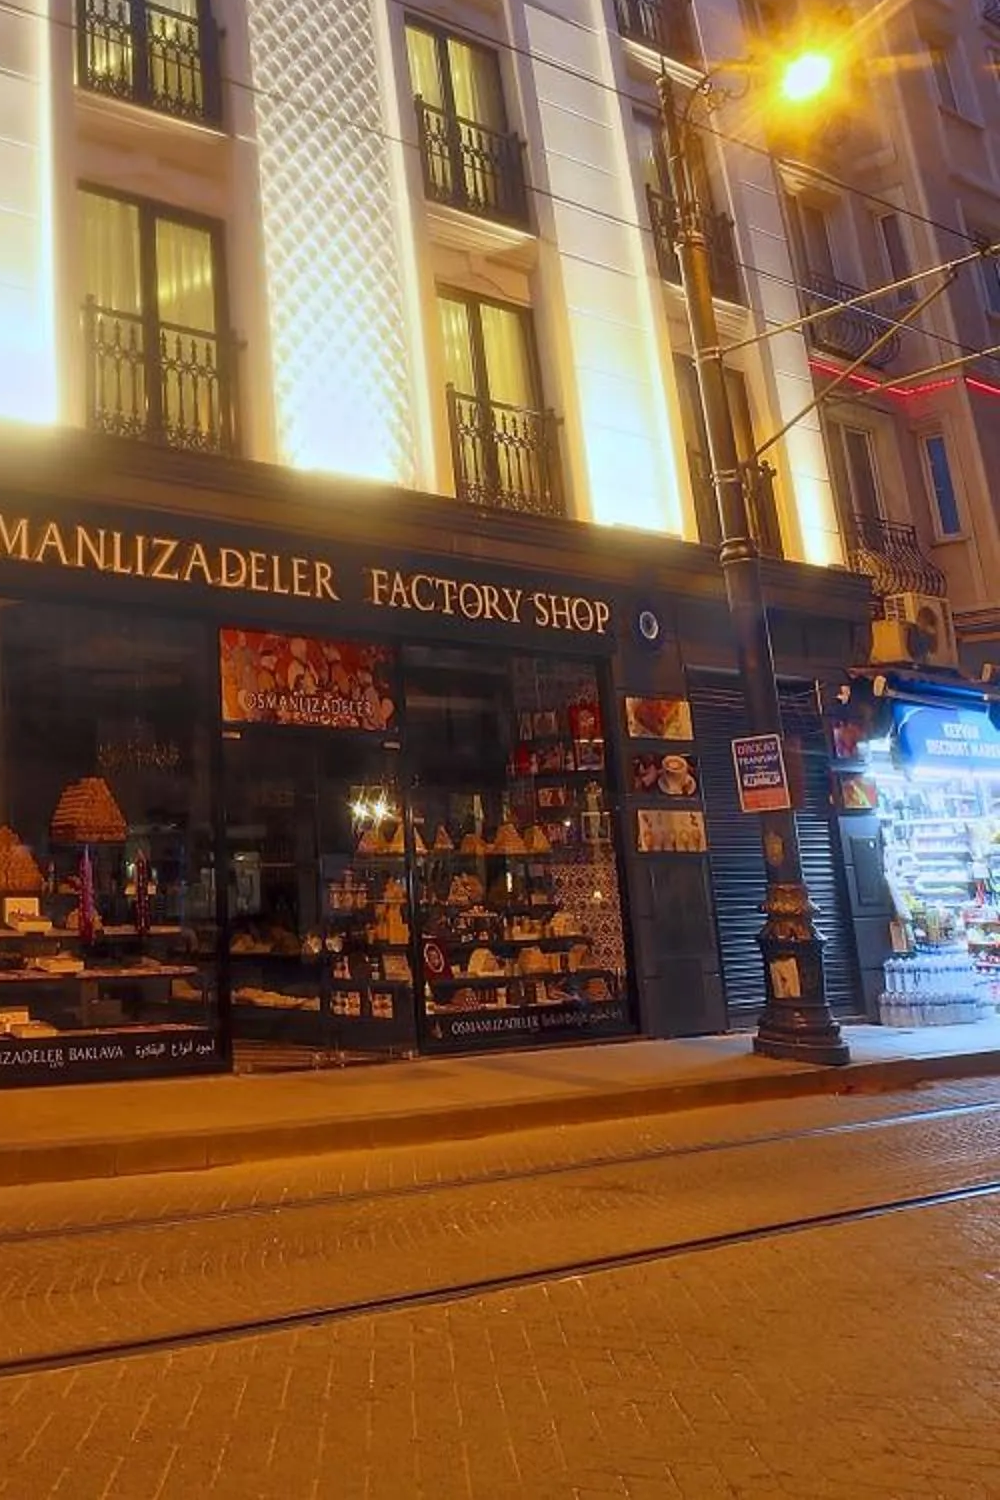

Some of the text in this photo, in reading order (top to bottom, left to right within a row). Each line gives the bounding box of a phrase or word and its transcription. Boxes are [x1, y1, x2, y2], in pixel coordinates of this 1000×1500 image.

[371, 568, 522, 623] FACTORY
[533, 592, 610, 634] SHOP
[246, 691, 373, 717] OSMANLIZADELER
[69, 1046, 123, 1062] BAKLAVA
